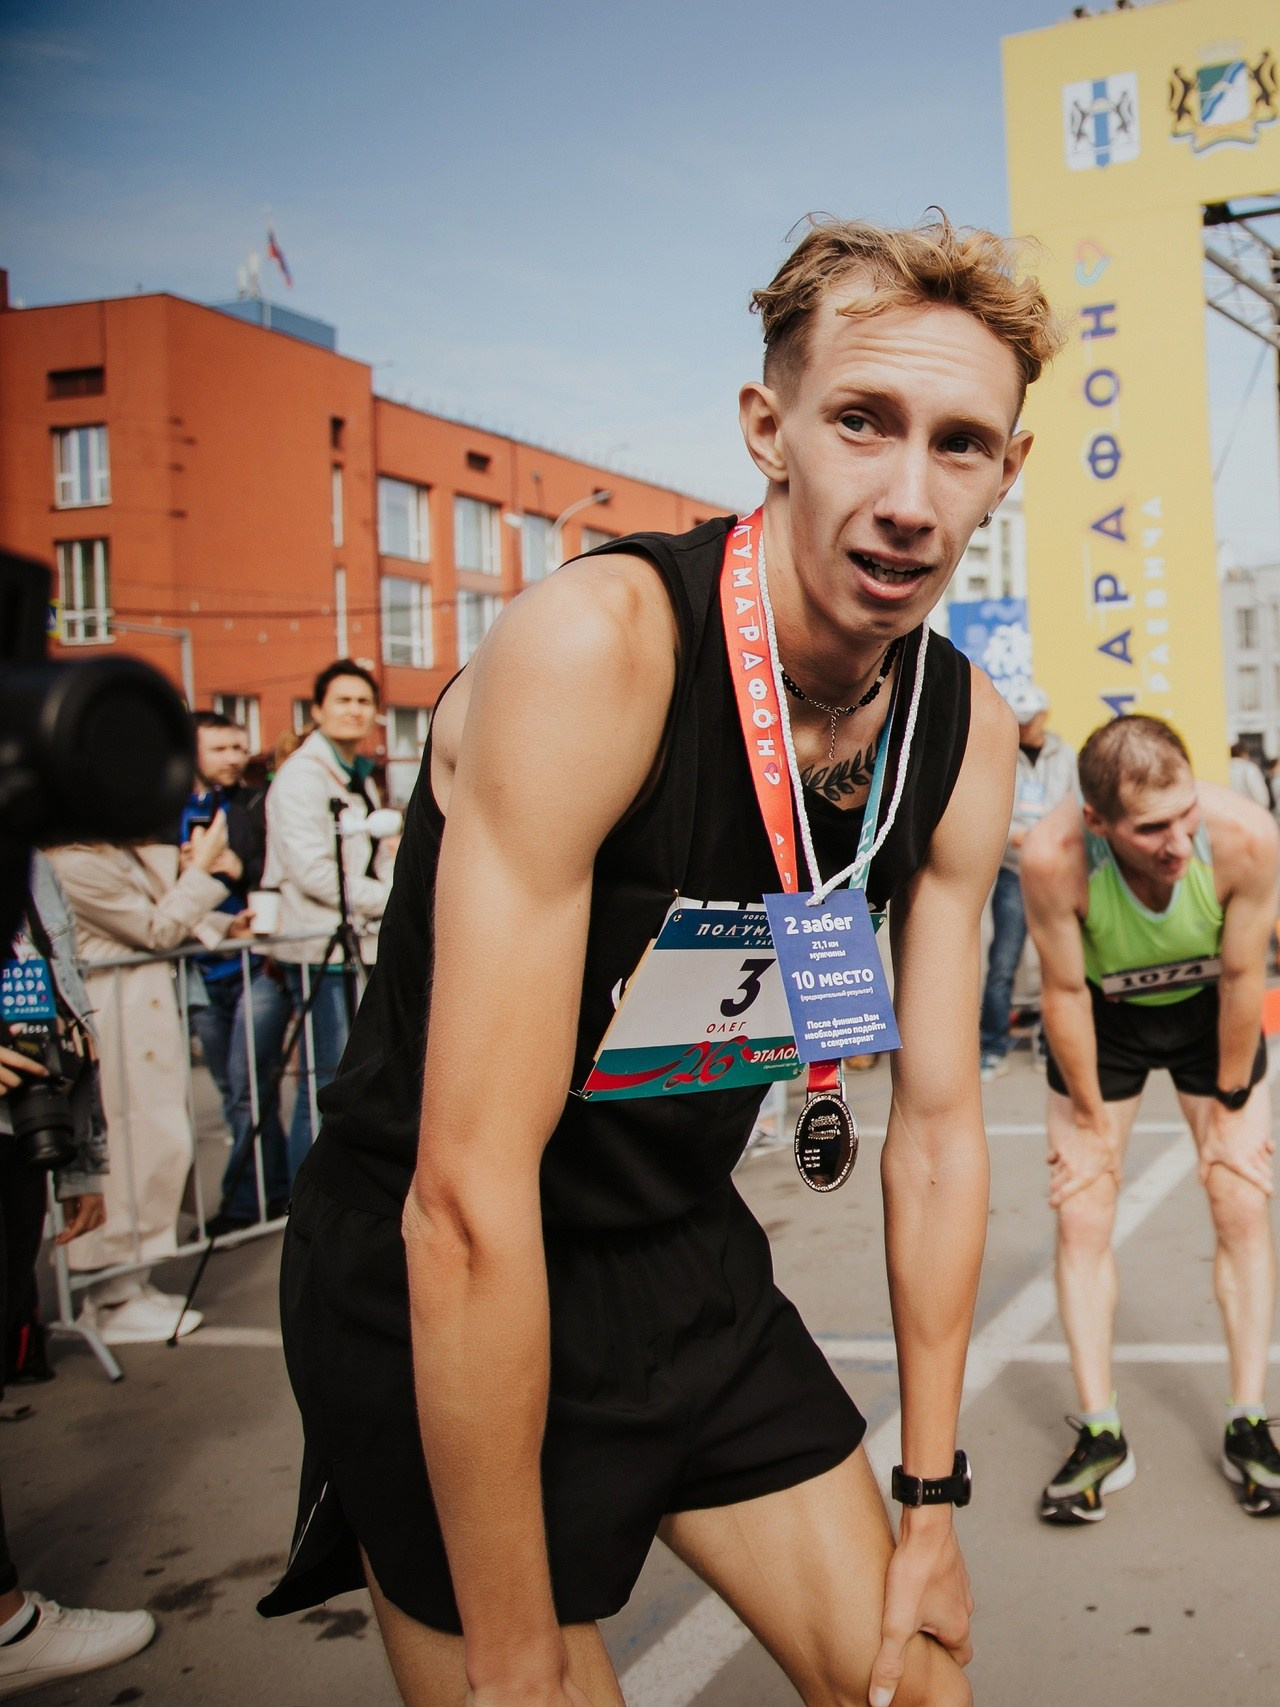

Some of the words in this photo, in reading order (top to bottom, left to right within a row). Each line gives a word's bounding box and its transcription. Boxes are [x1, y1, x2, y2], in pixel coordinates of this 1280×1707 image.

[784, 916, 799, 935] 2
[802, 913, 853, 934] забег
[812, 939, 827, 950] 21,1
[828, 939, 839, 948] км
[809, 949, 846, 961] мужчины
[792, 970, 815, 990] 10
[818, 968, 874, 988] место
[1121, 965, 1203, 987] 1074
[720, 959, 776, 1018] 3
[706, 1021, 747, 1034] ОЛЕГ
[807, 1018, 831, 1030] После
[832, 1015, 863, 1028] финиша
[864, 1013, 880, 1023] Вам
[804, 1026, 853, 1040] необходимо
[853, 1022, 887, 1035] подойти
[821, 1040, 827, 1048] в
[827, 1034, 875, 1048] секретариат
